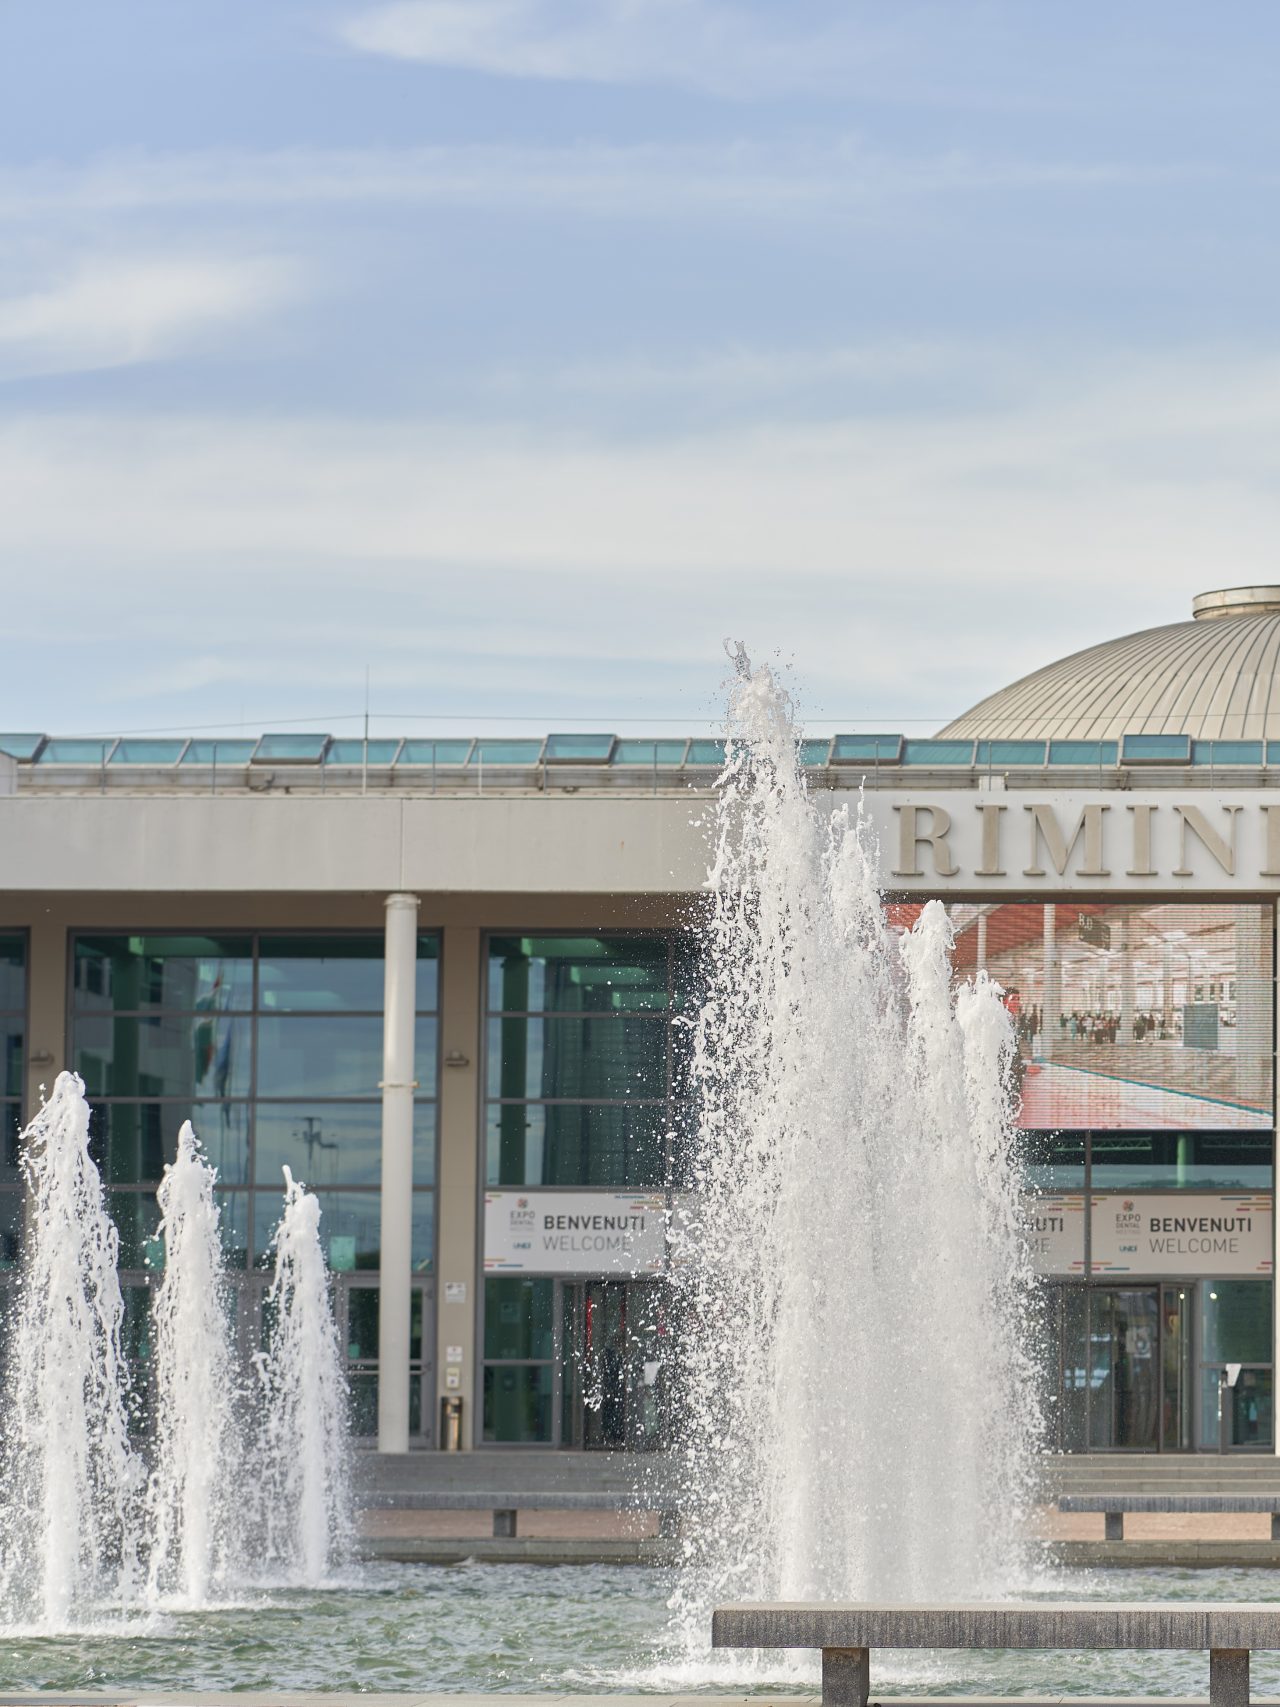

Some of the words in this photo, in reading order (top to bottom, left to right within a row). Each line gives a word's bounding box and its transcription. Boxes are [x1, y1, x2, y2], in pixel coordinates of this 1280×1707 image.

[543, 1215, 645, 1231] BENVENUTI
[1115, 1213, 1141, 1222] EXPO
[1149, 1217, 1252, 1233] BENVENUTI
[542, 1235, 631, 1252] WELCOME
[1148, 1237, 1239, 1254] WELCOME
